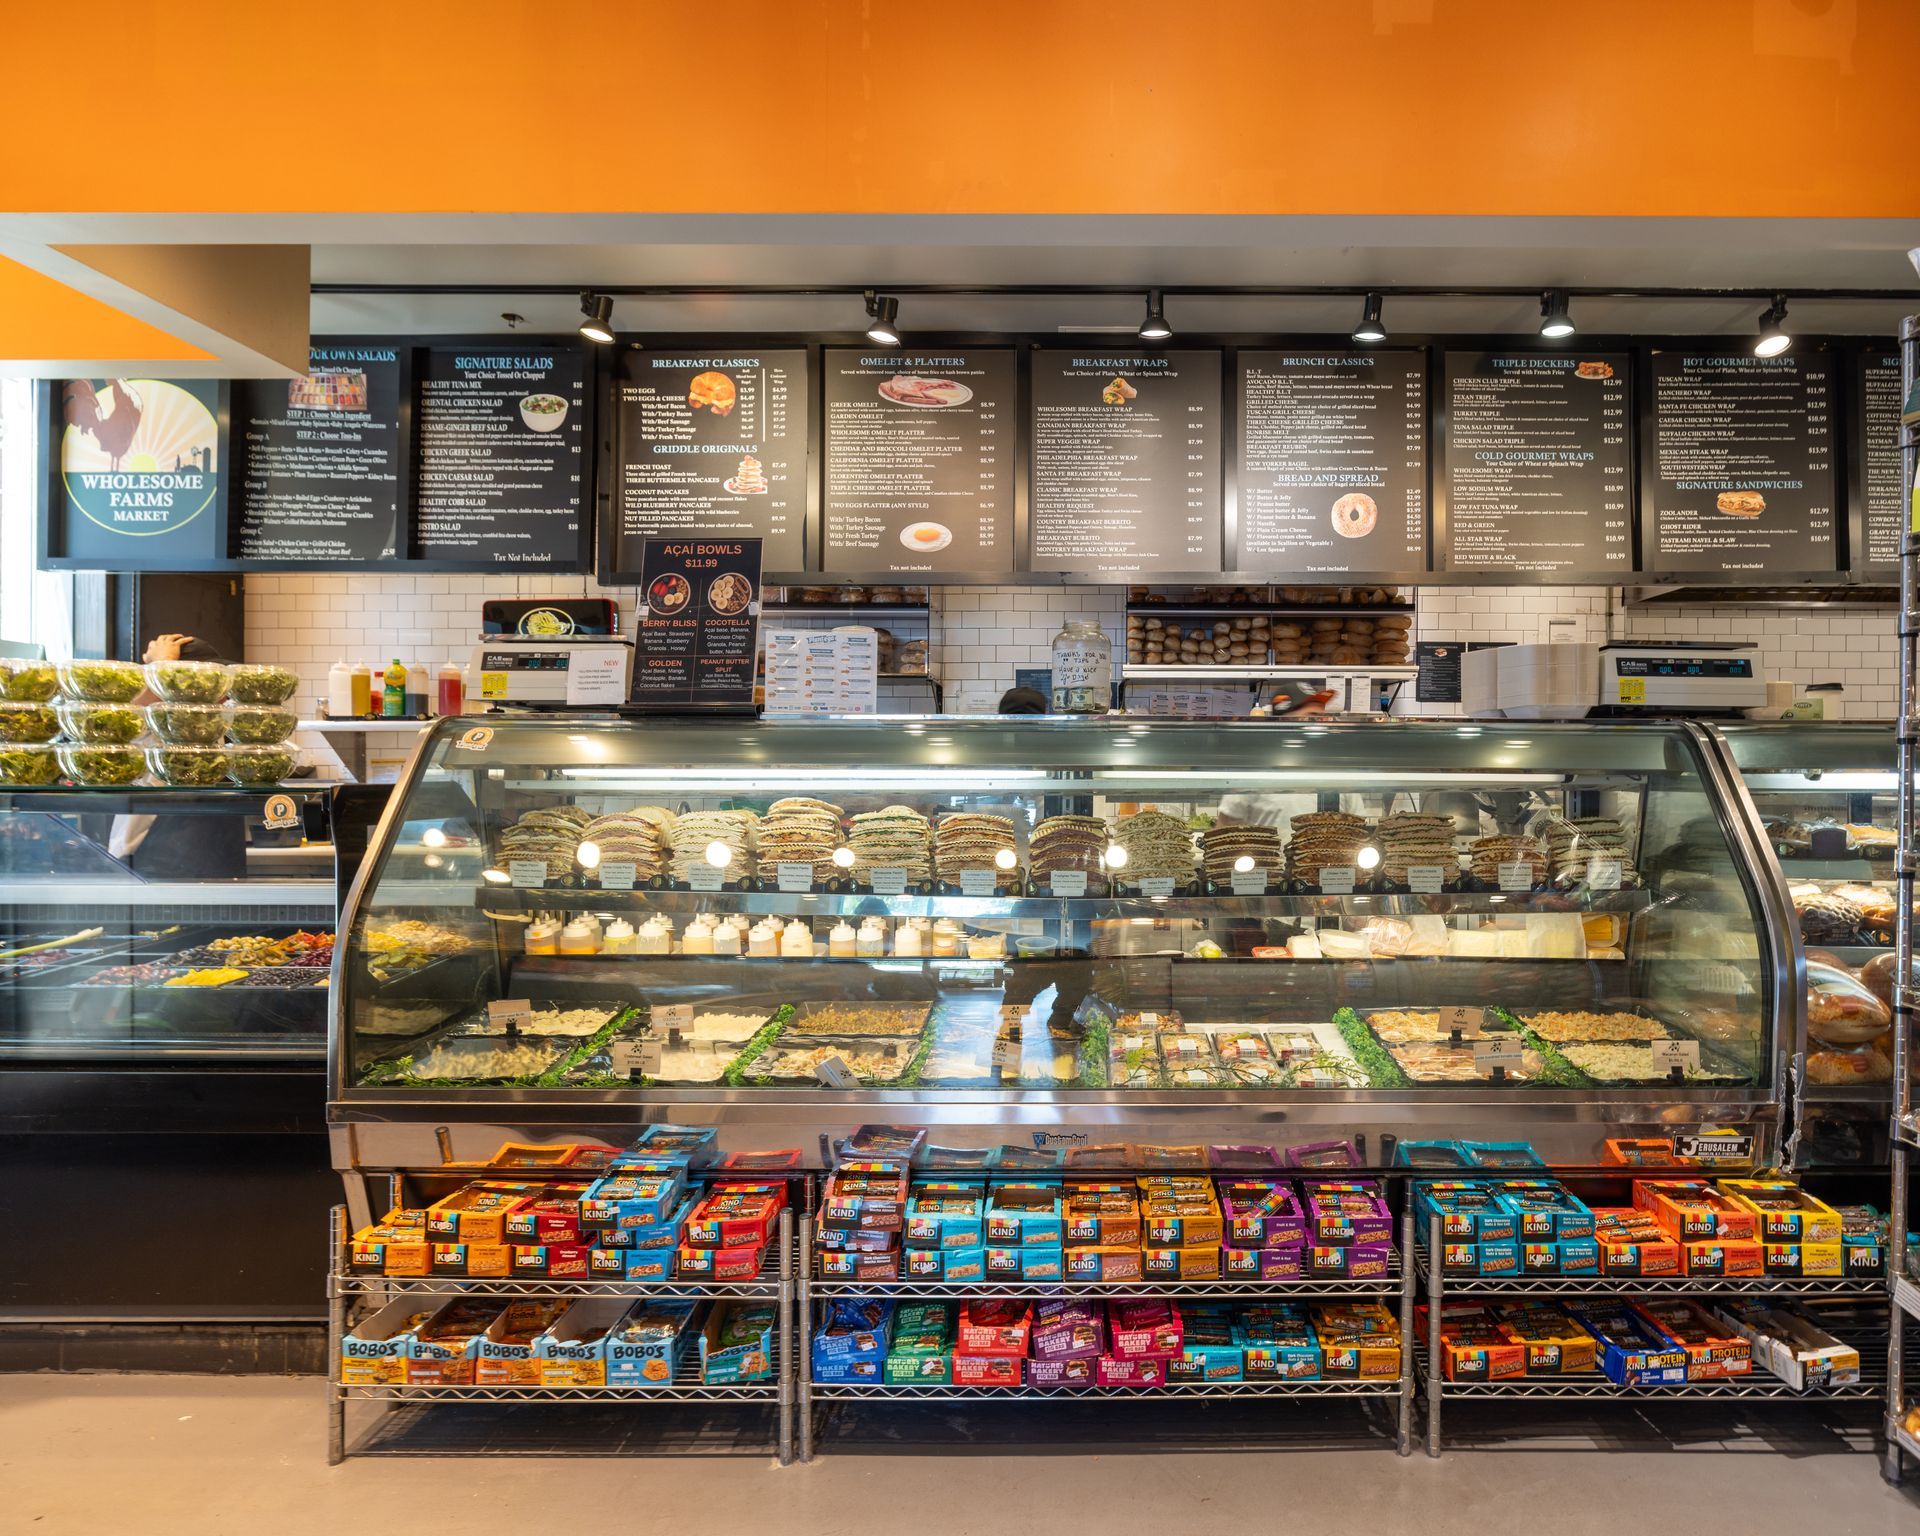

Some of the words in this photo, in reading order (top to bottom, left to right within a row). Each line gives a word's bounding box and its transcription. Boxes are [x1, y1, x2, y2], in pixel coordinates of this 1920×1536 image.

[328, 349, 355, 362] OWN
[356, 349, 396, 362] SALADS
[455, 357, 513, 370] SIGNATURE
[514, 357, 554, 370] SALADS
[652, 359, 711, 368] BREAKFAST
[712, 359, 760, 368] CLASSICS
[860, 357, 903, 366] OMELET
[914, 357, 965, 366] PLATTERS
[1072, 358, 1131, 367] BREAKFAST
[1132, 358, 1168, 367] WRAPS
[1283, 358, 1325, 366] BRUNCH
[1327, 358, 1374, 366] CLASSICS
[1492, 359, 1527, 368] TRIPLE
[1529, 359, 1575, 368] DECKERS
[1683, 357, 1705, 367] HOT
[1706, 357, 1758, 367] GOURMET
[1758, 357, 1795, 367] WRAPS
[464, 371, 477, 381] Your
[477, 371, 496, 381] Choice
[496, 371, 514, 381] Tossed
[514, 371, 521, 381] Or
[522, 371, 545, 381] Chopped
[1806, 387, 1826, 395] $11.99
[421, 423, 470, 432] SESAME-GINGER
[471, 423, 486, 432] BEEF
[486, 423, 508, 432] SALAD
[246, 431, 264, 442] Group
[653, 445, 700, 454] GRIDDLE
[701, 445, 758, 454] ORIGINALS
[1475, 452, 1504, 461] COLD
[1505, 452, 1557, 461] GOURMET
[1559, 452, 1594, 461] WRAPS
[419, 473, 448, 481] CHICKEN
[448, 473, 472, 481] CAESAR
[473, 473, 494, 481] SALAD
[1278, 474, 1313, 482] BREAD
[1314, 474, 1338, 482] AND
[1339, 474, 1379, 482] SPREAD
[82, 474, 203, 491] WHOLESOME
[245, 480, 262, 491] Group
[1676, 480, 1734, 490] SIGNATURE
[1735, 480, 1803, 490] SANDWICHES
[110, 492, 173, 508] FARMS
[113, 510, 169, 522] MARKET
[1810, 507, 1829, 515] $12.99
[240, 526, 257, 537] Group
[664, 542, 694, 556] AÇAÍ
[697, 544, 742, 555] BOWLS
[685, 558, 718, 569] $11.99
[642, 619, 671, 628] BERRY
[672, 619, 697, 628] BLISS
[603, 659, 619, 667] NEW
[648, 659, 682, 667] GOLDEN
[1681, 1140, 1739, 1156] JERUSALEM
[585, 1209, 610, 1219] KIND
[829, 1208, 855, 1218] KIND
[508, 1223, 532, 1232] KIND
[991, 1227, 1016, 1237] KIND
[1070, 1227, 1095, 1237] KIND
[1526, 1222, 1550, 1232] KIND
[1687, 1222, 1712, 1232] KIND
[1770, 1222, 1796, 1232] KIND
[692, 1230, 716, 1240] KIND
[819, 1230, 845, 1241] KIND
[355, 1253, 379, 1262] KIND
[1693, 1255, 1718, 1265] KIND
[1850, 1256, 1879, 1267] KIND
[594, 1259, 619, 1268] KIND
[1070, 1259, 1095, 1269] KIND
[1149, 1259, 1174, 1269] KIND
[348, 1342, 399, 1356] BOBO'S
[483, 1344, 530, 1359] BOBO'S
[613, 1345, 665, 1360] BOBO'S
[1712, 1347, 1750, 1358] PROTEIN
[1250, 1359, 1275, 1369] KIND
[1533, 1356, 1556, 1364] KIND
[1692, 1356, 1711, 1365] KIND
[1172, 1361, 1197, 1371] KIND
[1626, 1362, 1646, 1371] KIND
